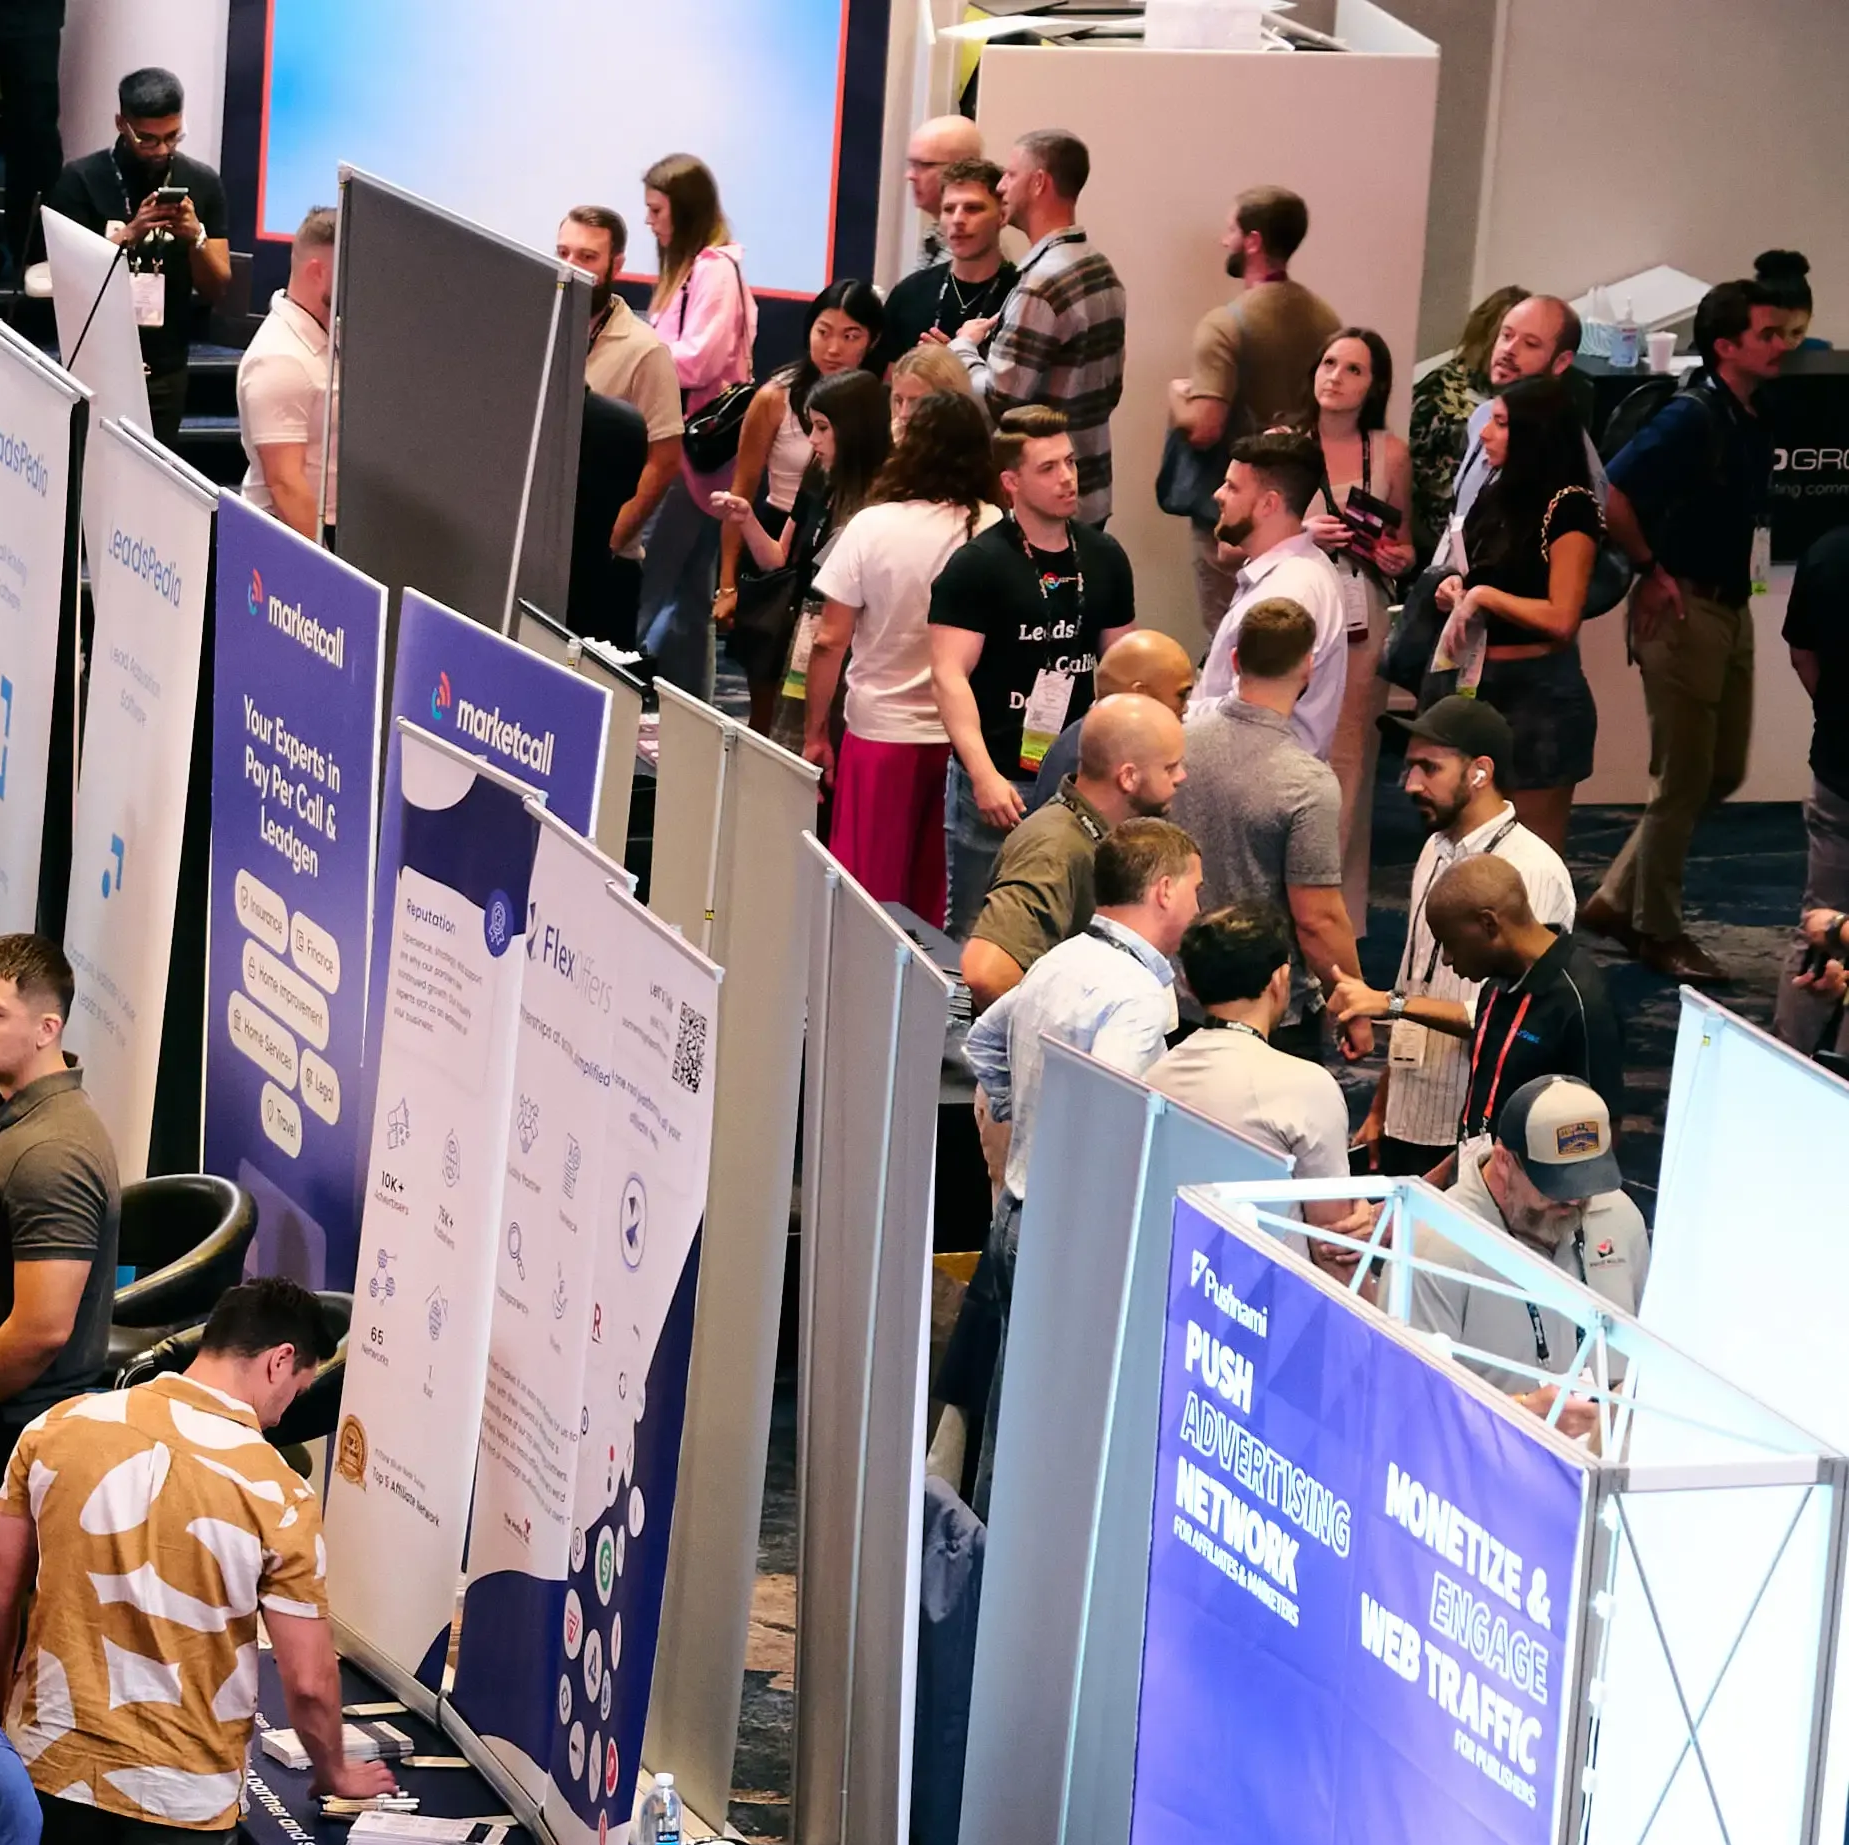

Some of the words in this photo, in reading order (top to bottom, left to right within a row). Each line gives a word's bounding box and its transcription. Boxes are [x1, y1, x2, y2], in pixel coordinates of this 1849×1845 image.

[108, 518, 181, 607] LeadsPedia
[268, 595, 344, 669] marketcall
[244, 694, 273, 745] Your
[275, 717, 325, 780] Experts
[328, 754, 341, 793] in
[457, 700, 555, 776] marketcall
[245, 745, 269, 798] Pay
[272, 767, 295, 807] Per
[297, 783, 323, 831] Call
[326, 807, 337, 842] &
[260, 805, 318, 878] Leadgen
[250, 895, 283, 934] Insurance
[407, 898, 456, 936] Reputation
[306, 939, 334, 975] Finance
[314, 1072, 334, 1103] Legal
[381, 1170, 404, 1193] 10K+
[370, 1326, 384, 1345] 65
[1204, 1268, 1268, 1338] Pushnami
[1185, 1320, 1254, 1414] PUSH
[1180, 1391, 1351, 1558] ADVERTISING
[1173, 1515, 1191, 1541] FOR
[1175, 1455, 1300, 1595] NETWORK
[1385, 1461, 1522, 1610] MONETIZE
[1527, 1567, 1551, 1630] &
[1429, 1570, 1549, 1705] ENGAGE
[1361, 1591, 1421, 1682] WEB
[1424, 1640, 1542, 1775] TRAFFIC
[1454, 1729, 1476, 1762] FOR
[247, 1777, 290, 1818] partner
[278, 1818, 315, 1840] and
